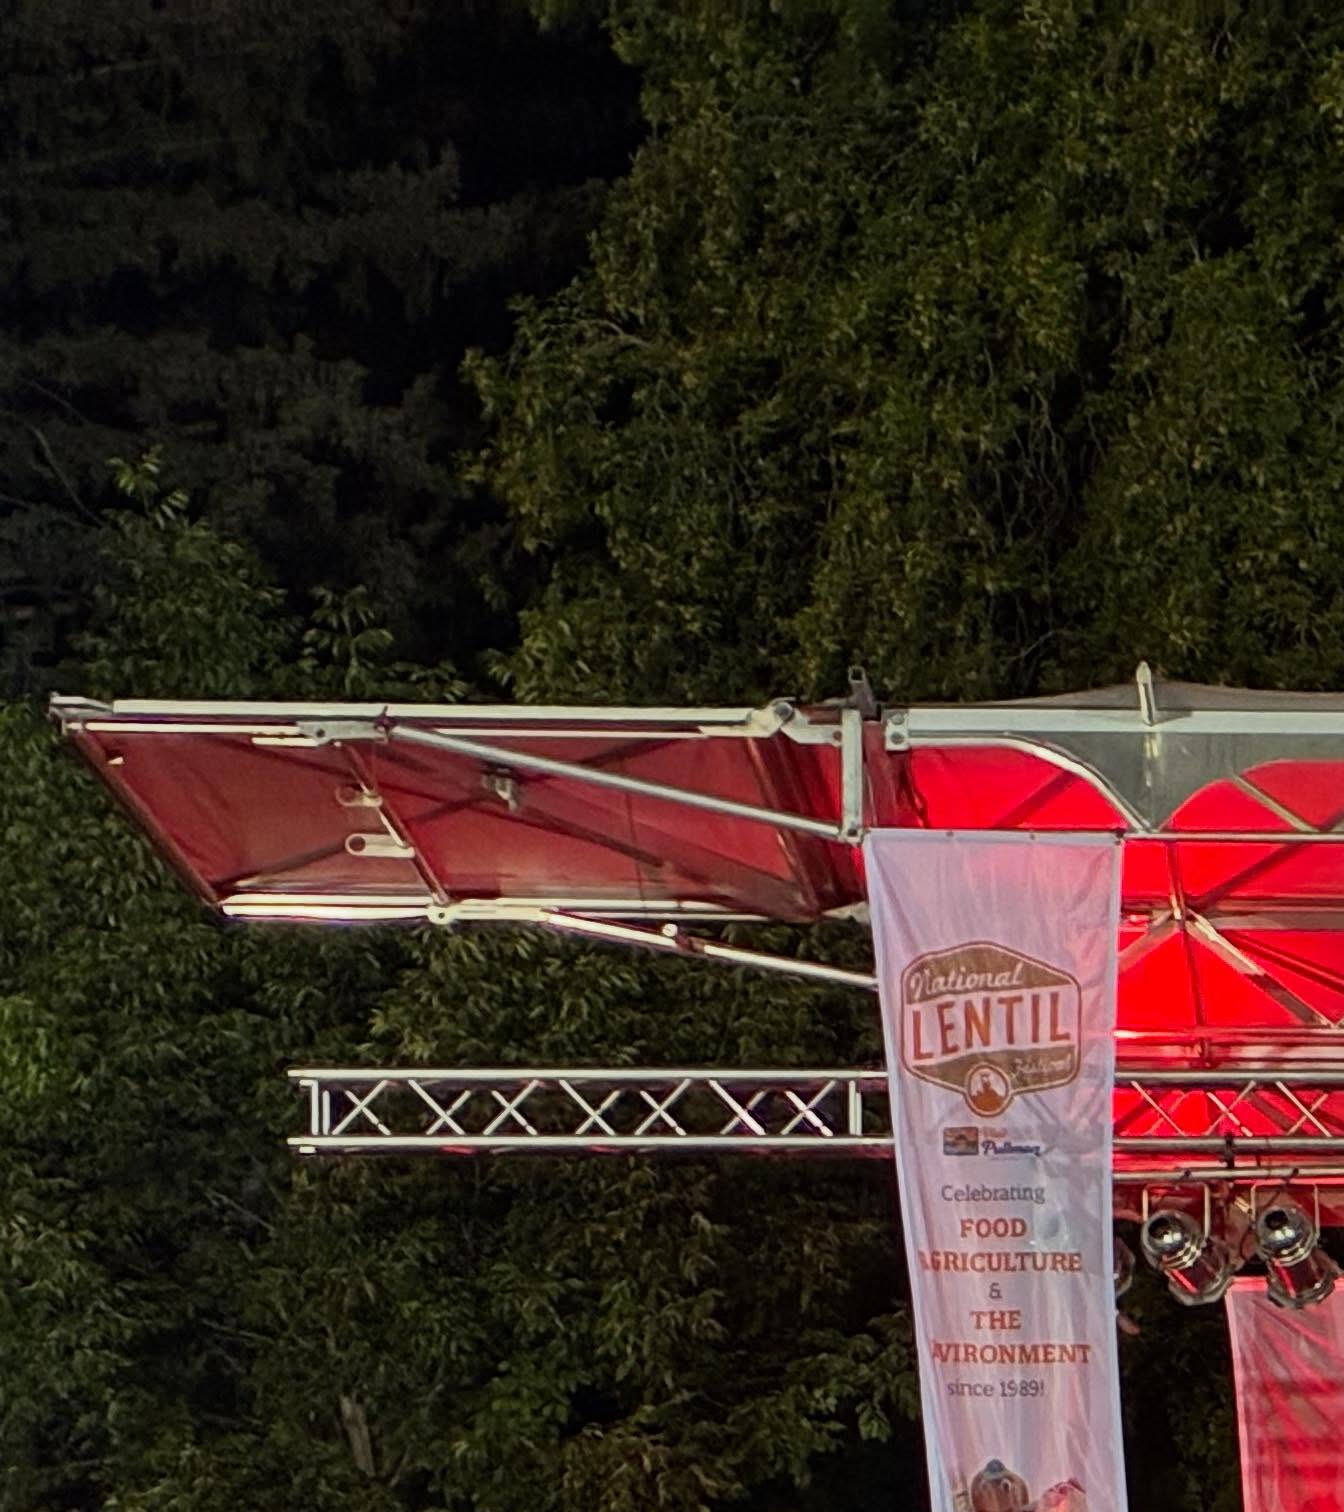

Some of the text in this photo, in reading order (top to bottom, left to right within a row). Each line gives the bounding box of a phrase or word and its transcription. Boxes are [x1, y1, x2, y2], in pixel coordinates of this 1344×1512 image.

[910, 961, 1025, 1000] National
[912, 991, 1072, 1060] LENTIL
[941, 1184, 1046, 1205] Celebrating
[960, 1218, 1027, 1239] FOOD
[988, 1282, 1002, 1299] &
[971, 1309, 1021, 1331] THE
[946, 1378, 1045, 1397] since 1989!
